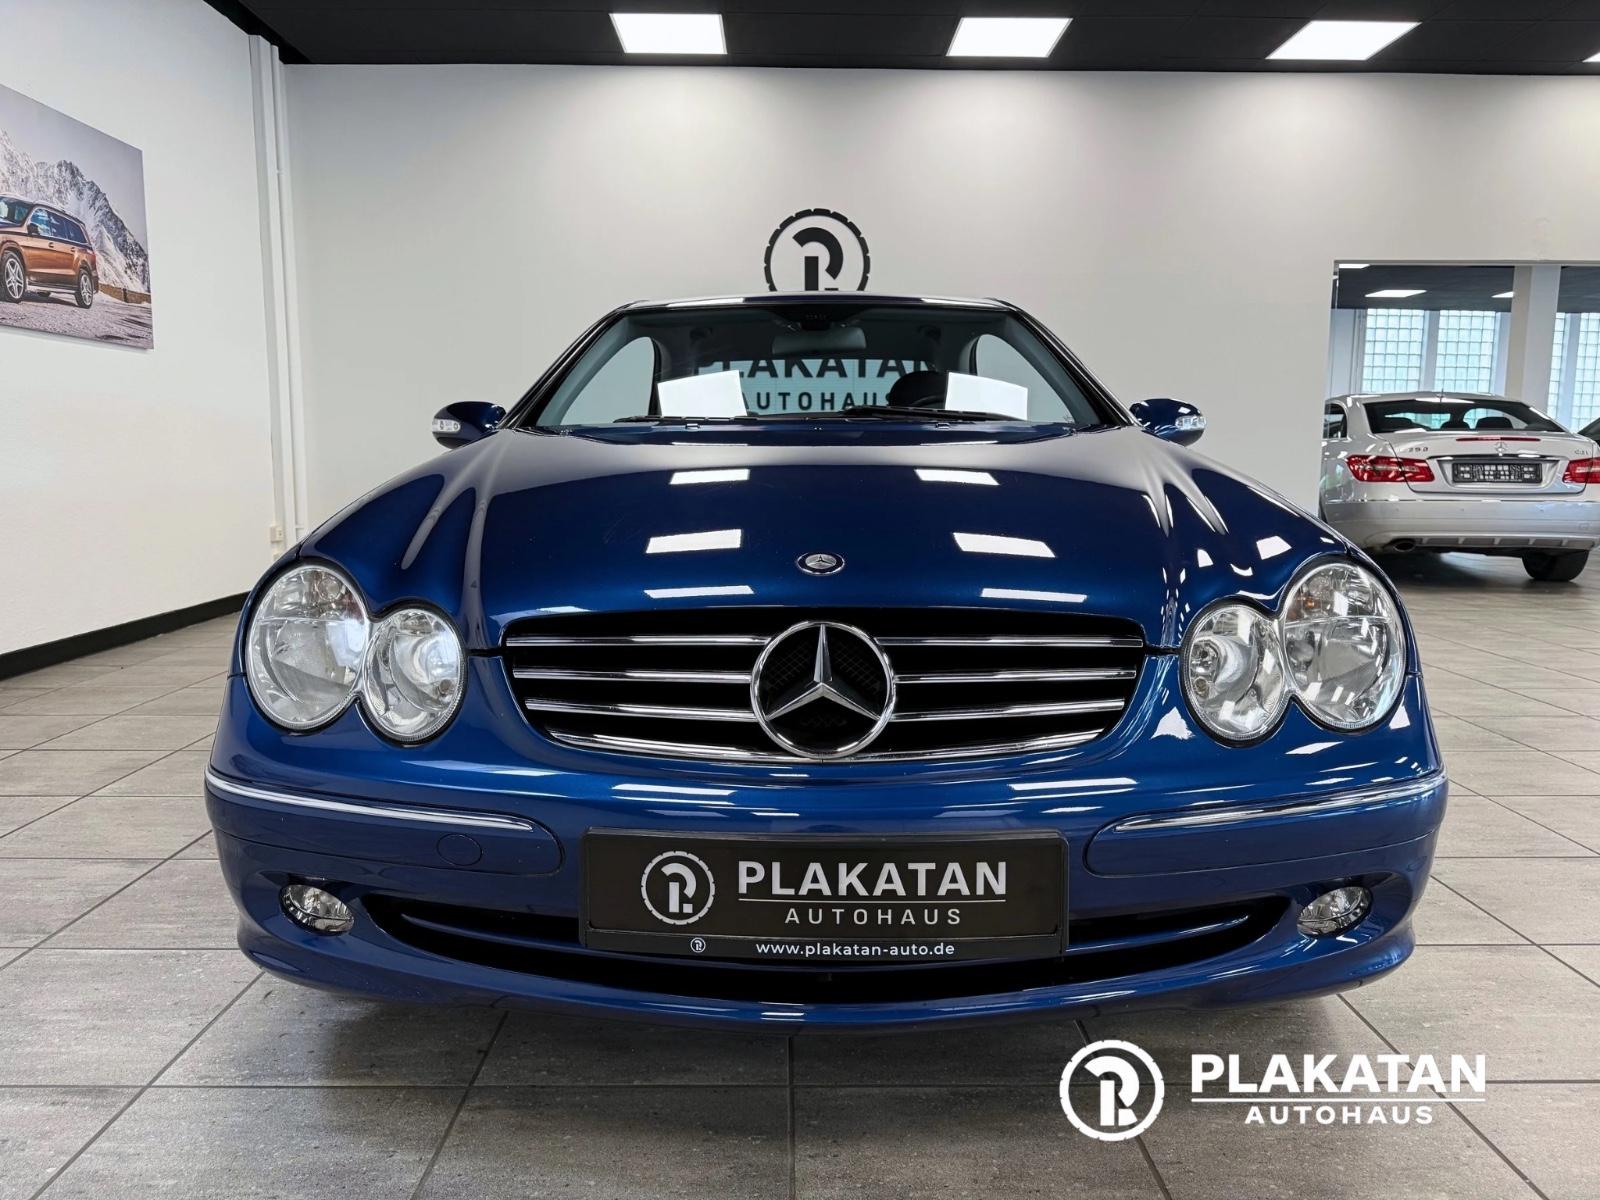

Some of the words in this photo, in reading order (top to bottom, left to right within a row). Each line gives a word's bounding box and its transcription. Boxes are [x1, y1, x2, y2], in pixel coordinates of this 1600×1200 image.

[742, 391, 892, 411] UTOHAU
[738, 861, 1007, 896] PLAKATAN
[785, 908, 962, 926] AUTOHAUS
[755, 942, 955, 958] www.plakatan-auto.de
